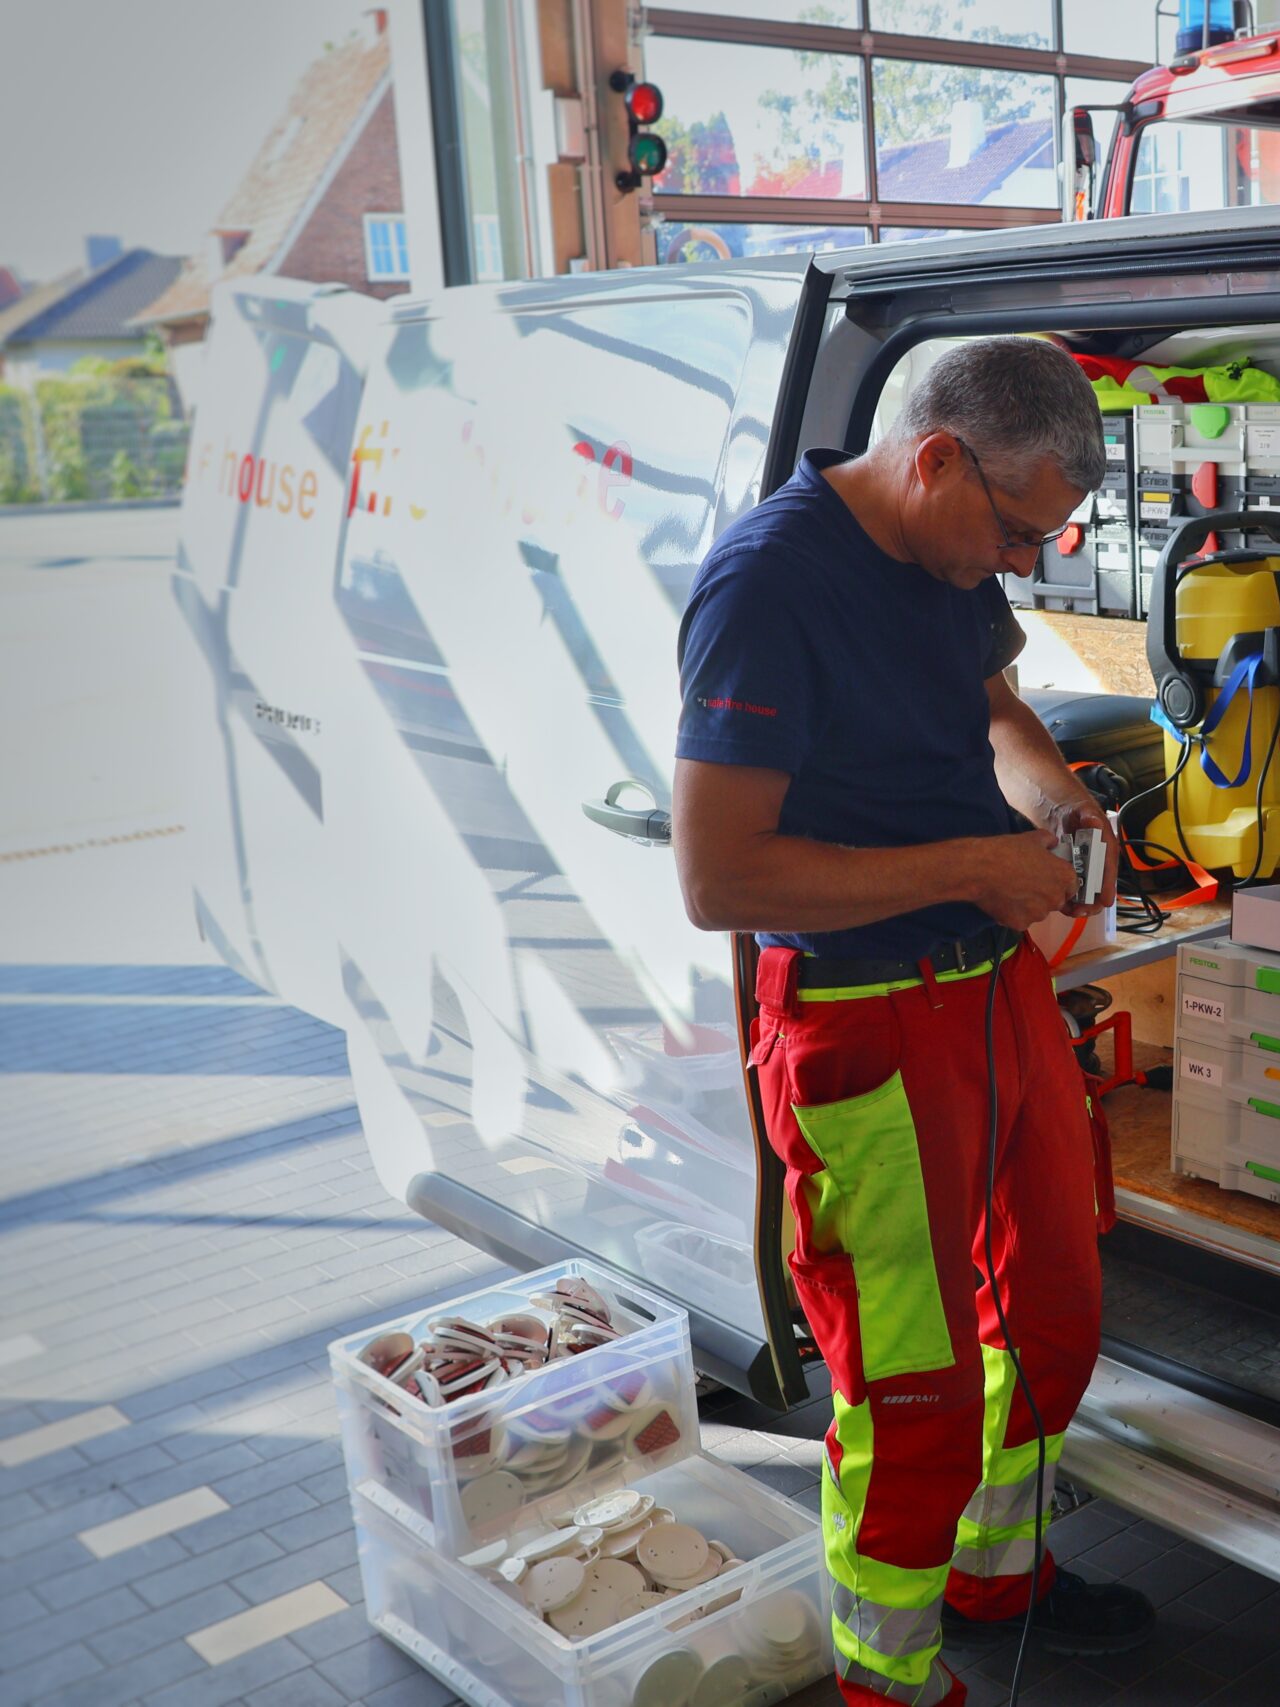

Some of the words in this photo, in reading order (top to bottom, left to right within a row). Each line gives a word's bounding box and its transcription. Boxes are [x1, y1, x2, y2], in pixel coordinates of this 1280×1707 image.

[218, 434, 318, 521] house
[1143, 477, 1169, 487] STIER
[745, 702, 777, 717] house
[1189, 957, 1221, 970] FESTOOL
[1184, 1000, 1222, 1017] 1-PKW-2
[1188, 1063, 1204, 1077] WK
